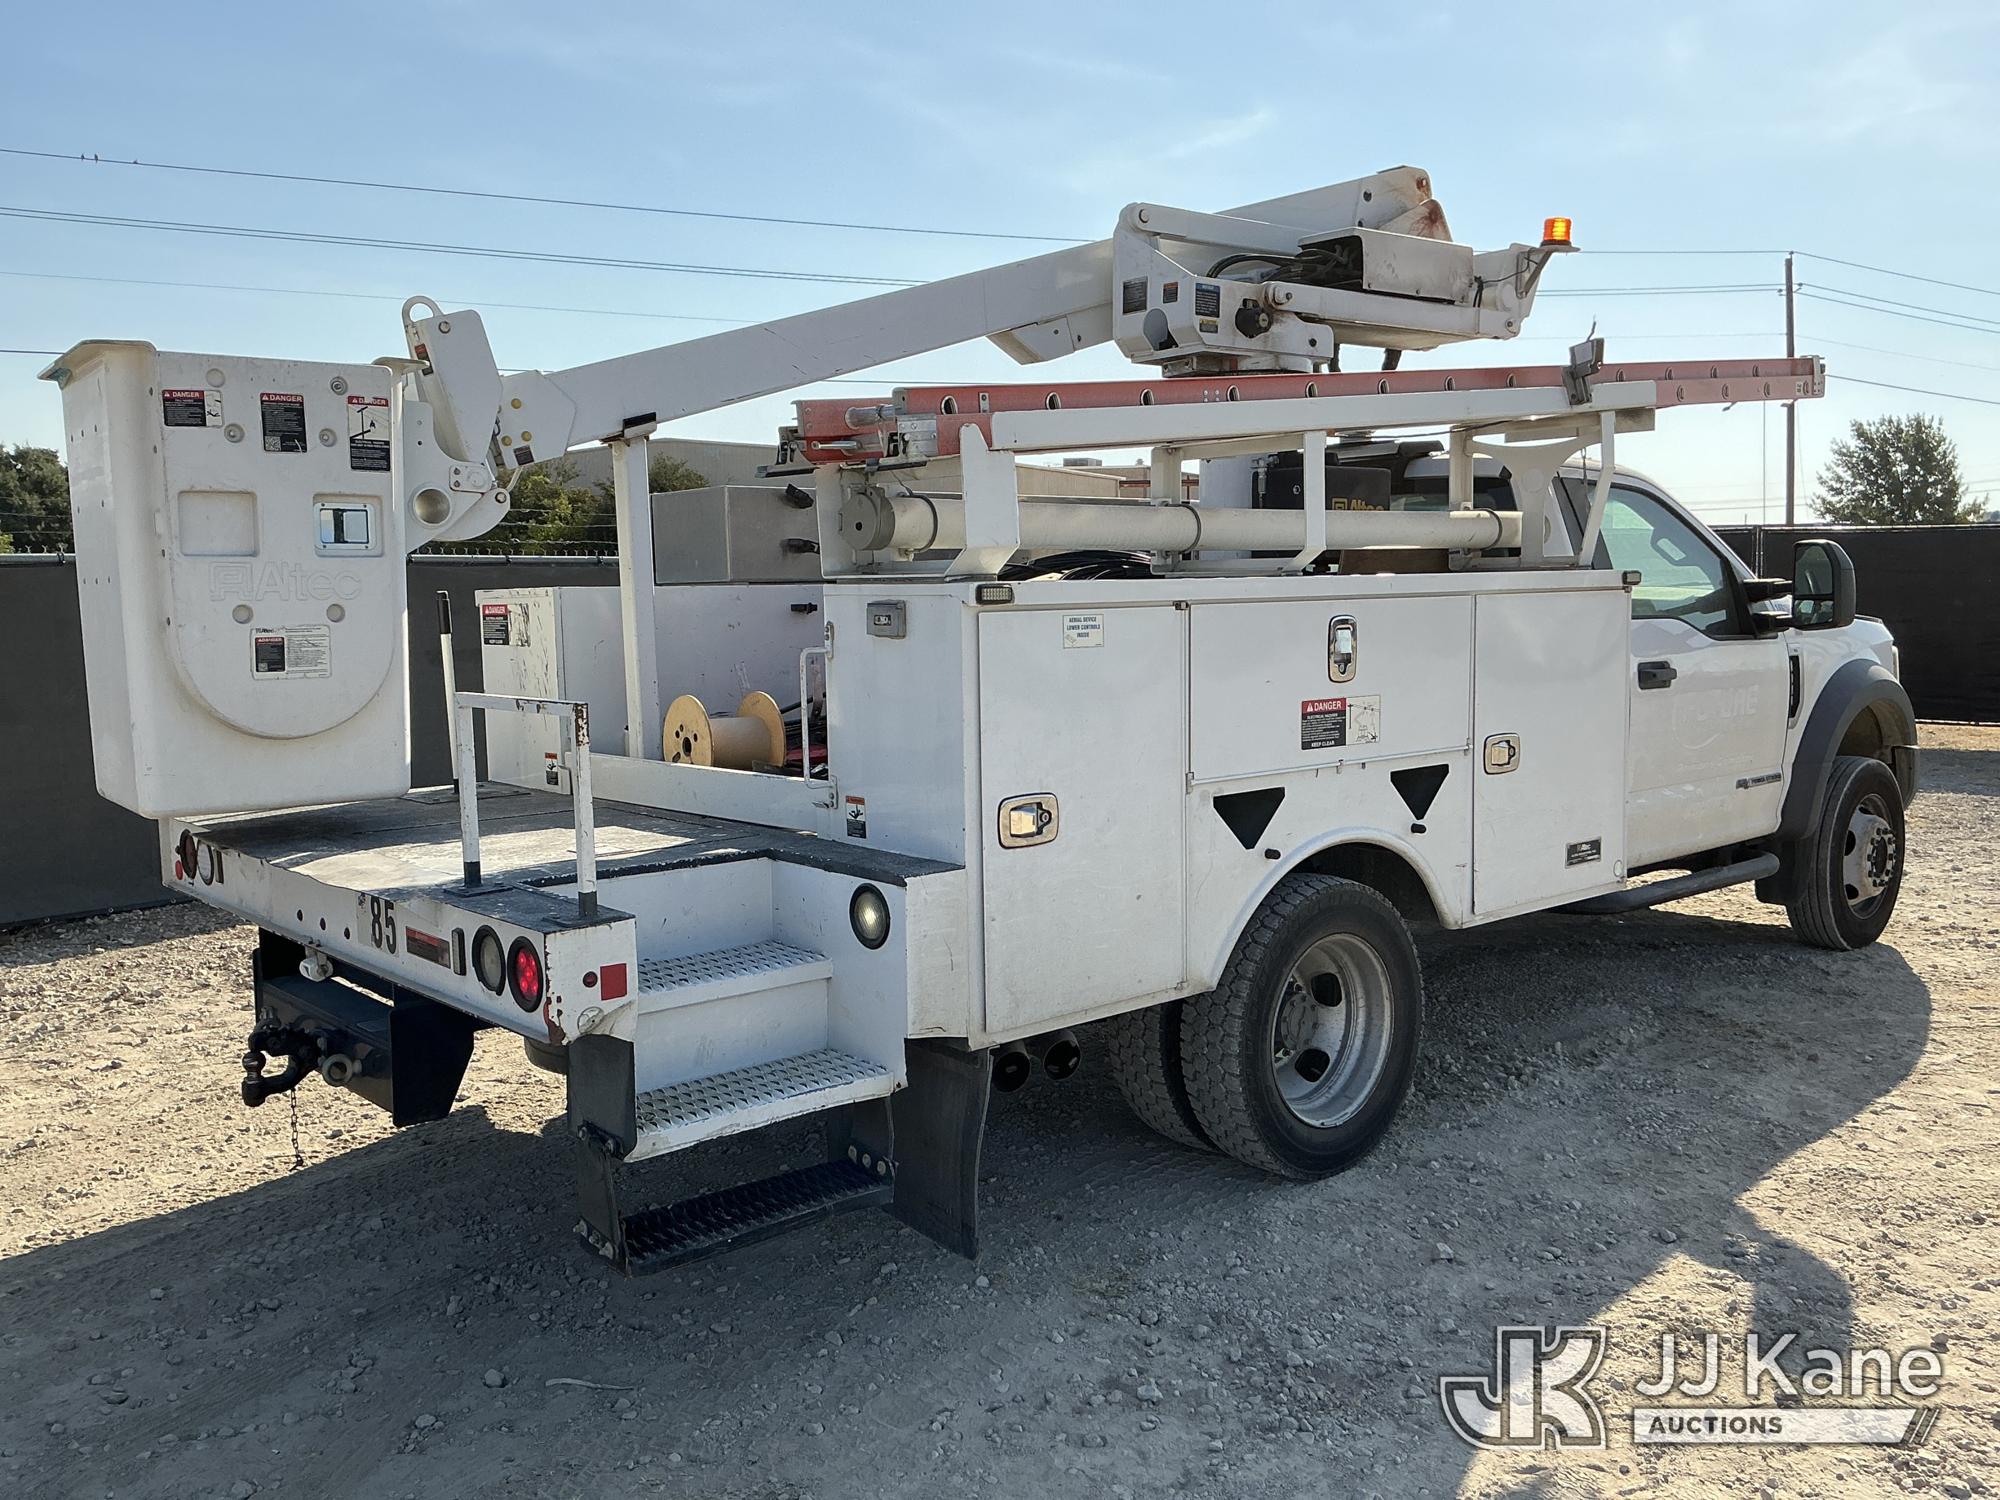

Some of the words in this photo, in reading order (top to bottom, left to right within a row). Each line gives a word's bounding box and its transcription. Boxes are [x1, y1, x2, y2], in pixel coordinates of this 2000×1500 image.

[269, 394, 303, 403] DANGER
[255, 560, 363, 602] Altec
[1314, 700, 1342, 712] DANGER
[1311, 740, 1321, 748] KEEP
[1321, 739, 1335, 747] CLEAR
[370, 895, 397, 955] 85
